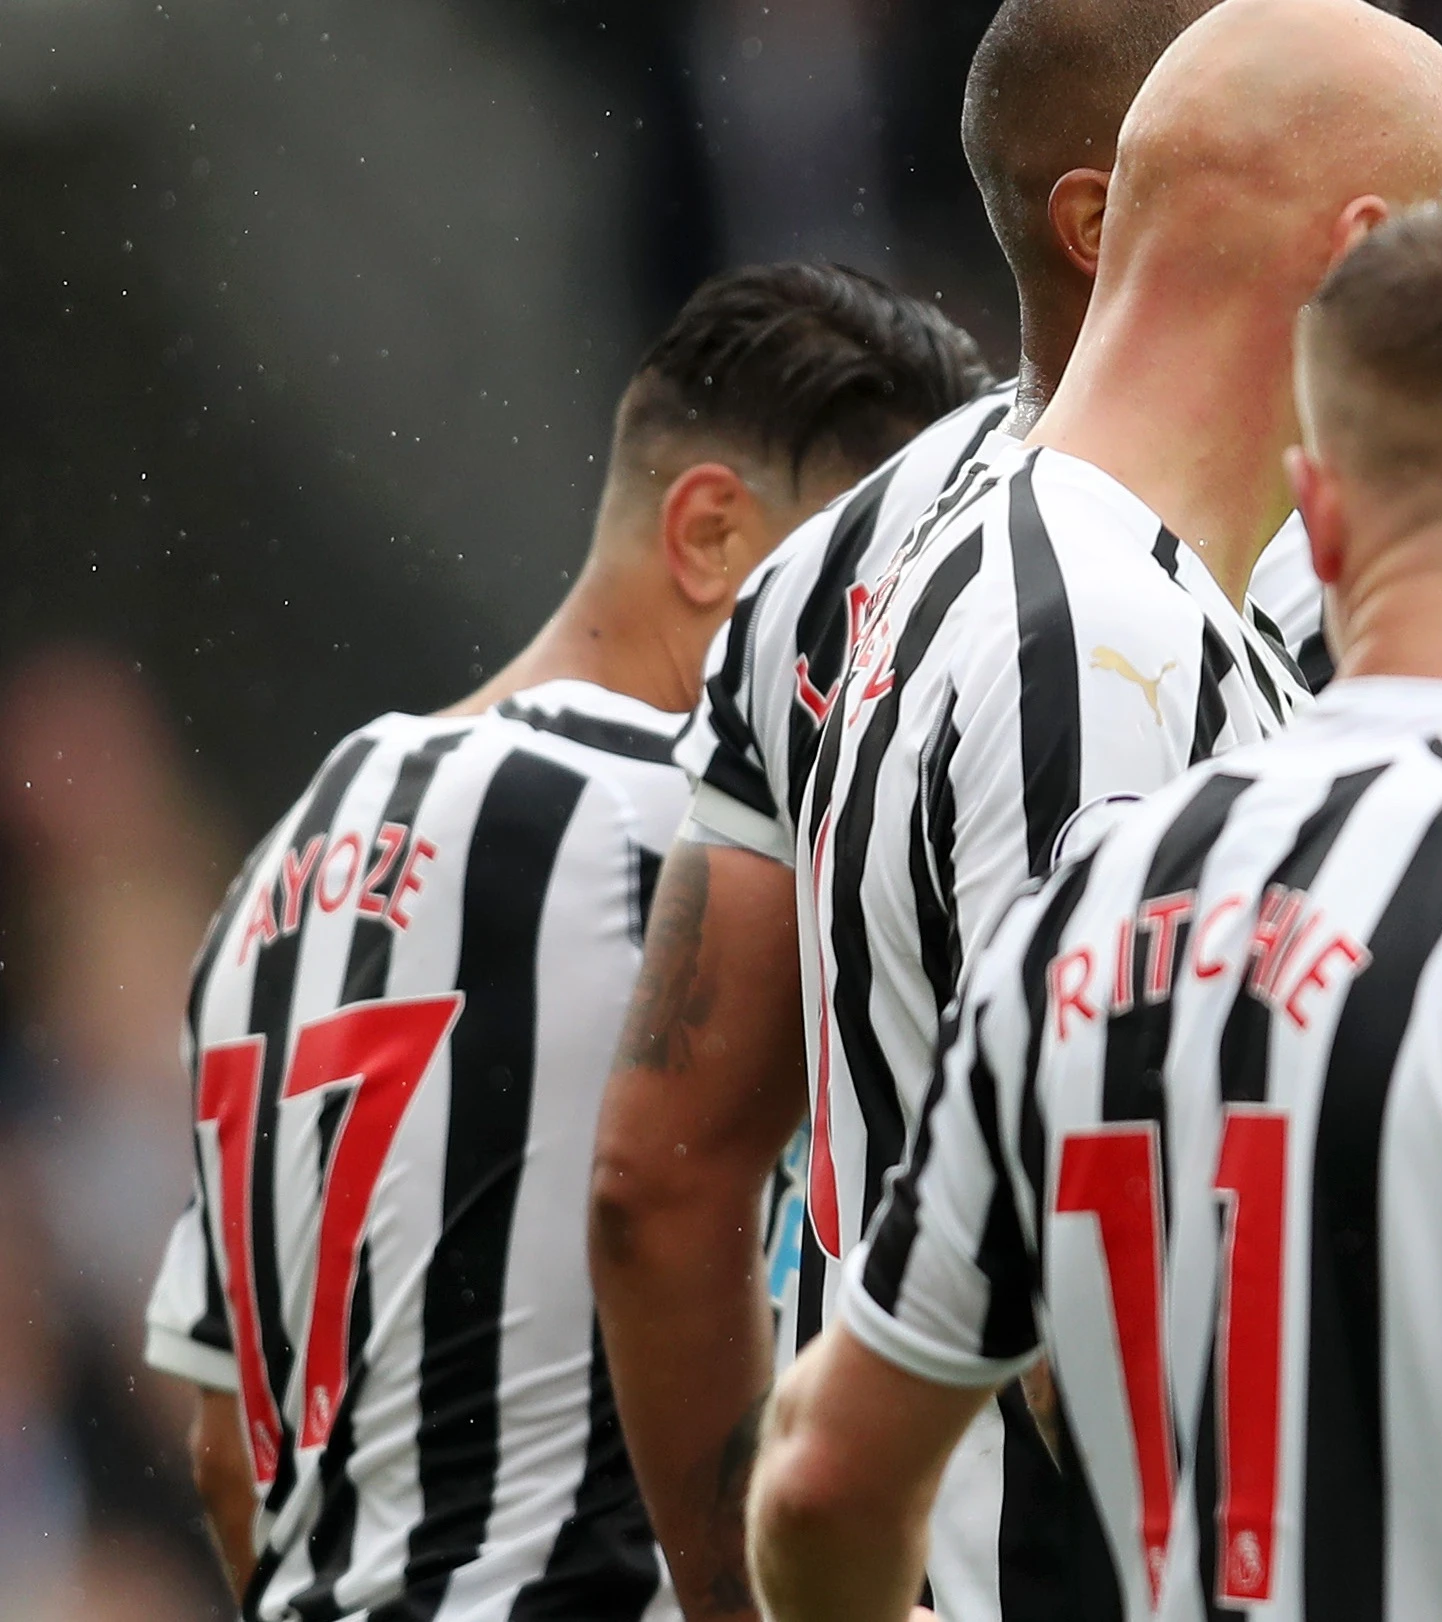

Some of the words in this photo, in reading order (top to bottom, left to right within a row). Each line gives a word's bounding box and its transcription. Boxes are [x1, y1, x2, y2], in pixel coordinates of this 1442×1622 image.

[237, 823, 438, 966] AYOZE
[1046, 885, 1373, 1041] RITCHIE
[197, 993, 463, 1483] 17
[1054, 1106, 1290, 1612] 11
